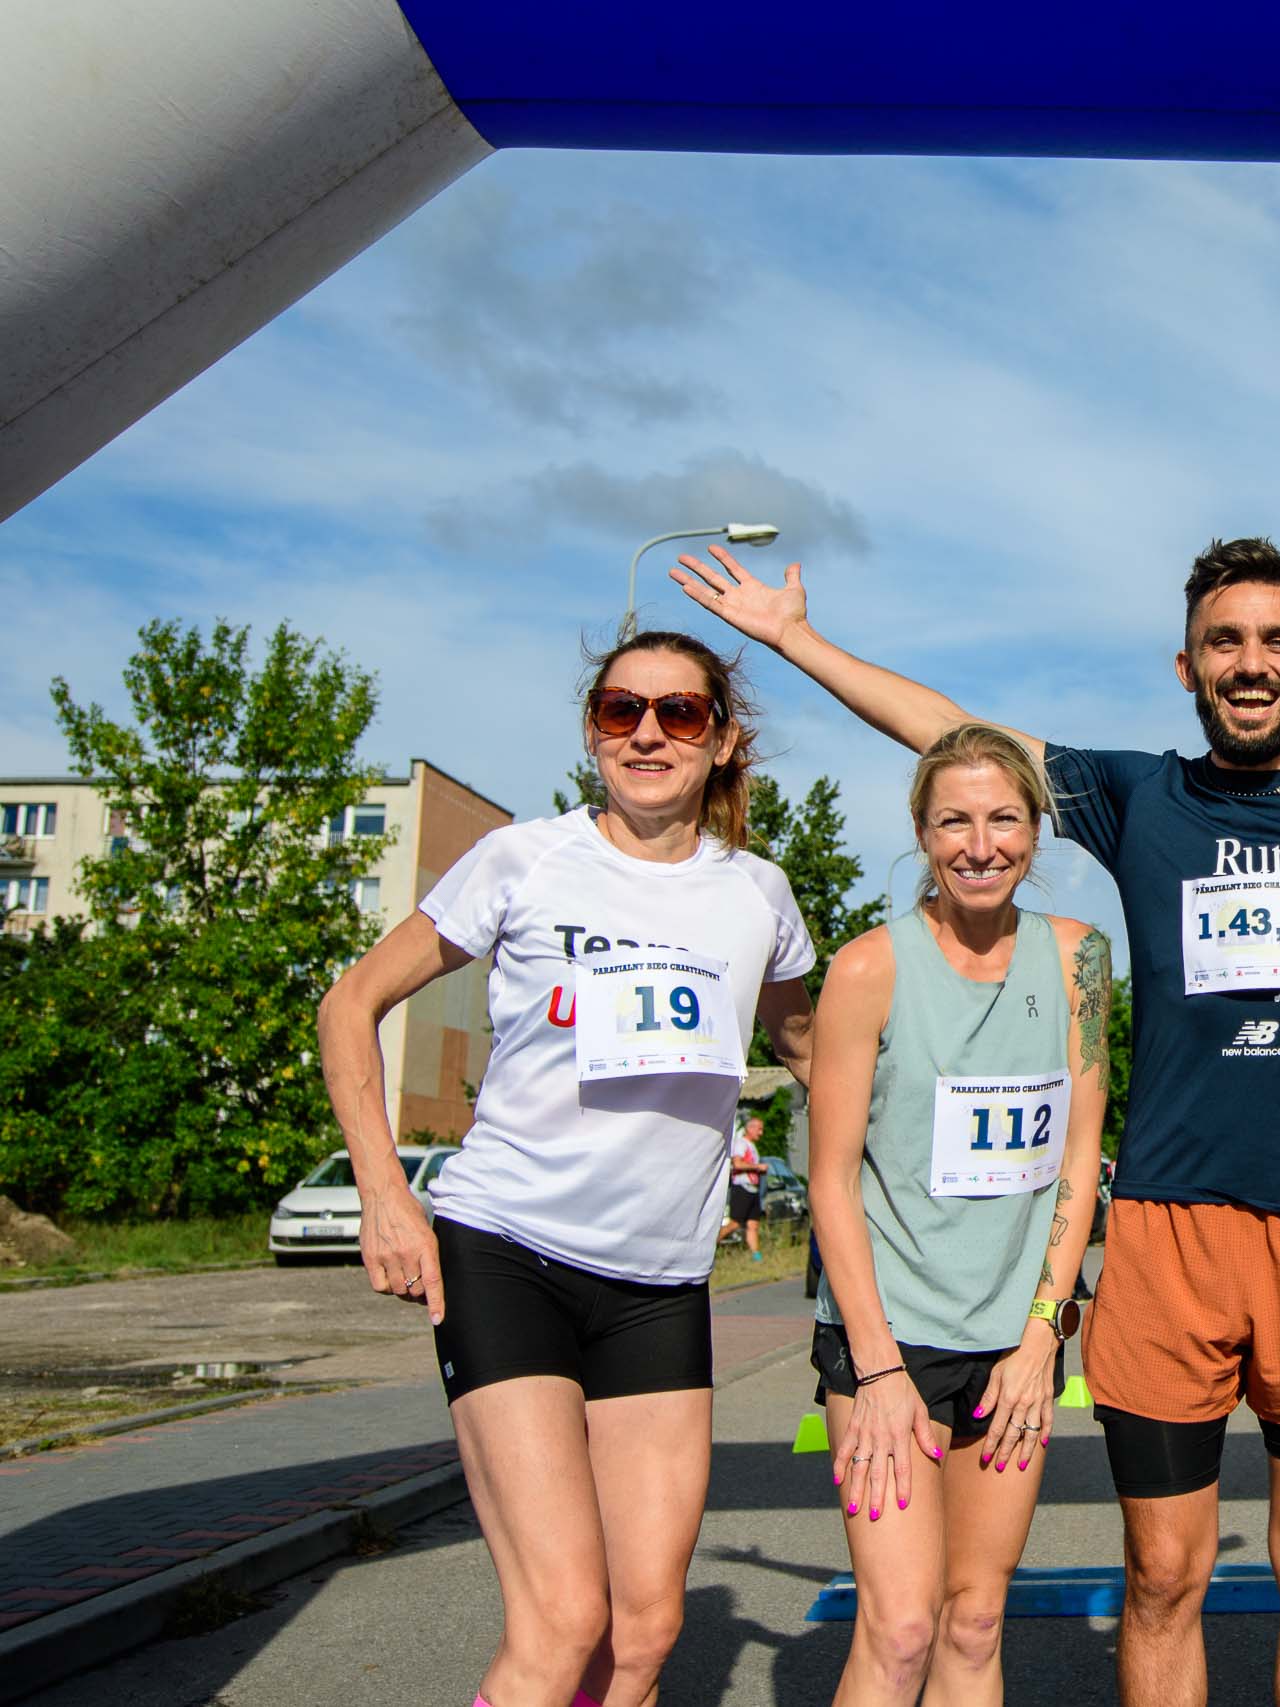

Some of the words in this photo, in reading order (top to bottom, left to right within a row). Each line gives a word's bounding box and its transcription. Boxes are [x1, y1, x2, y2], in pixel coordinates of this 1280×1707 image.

[635, 986, 700, 1031] 19
[1222, 1047, 1242, 1056] new
[971, 1103, 1052, 1150] 112
